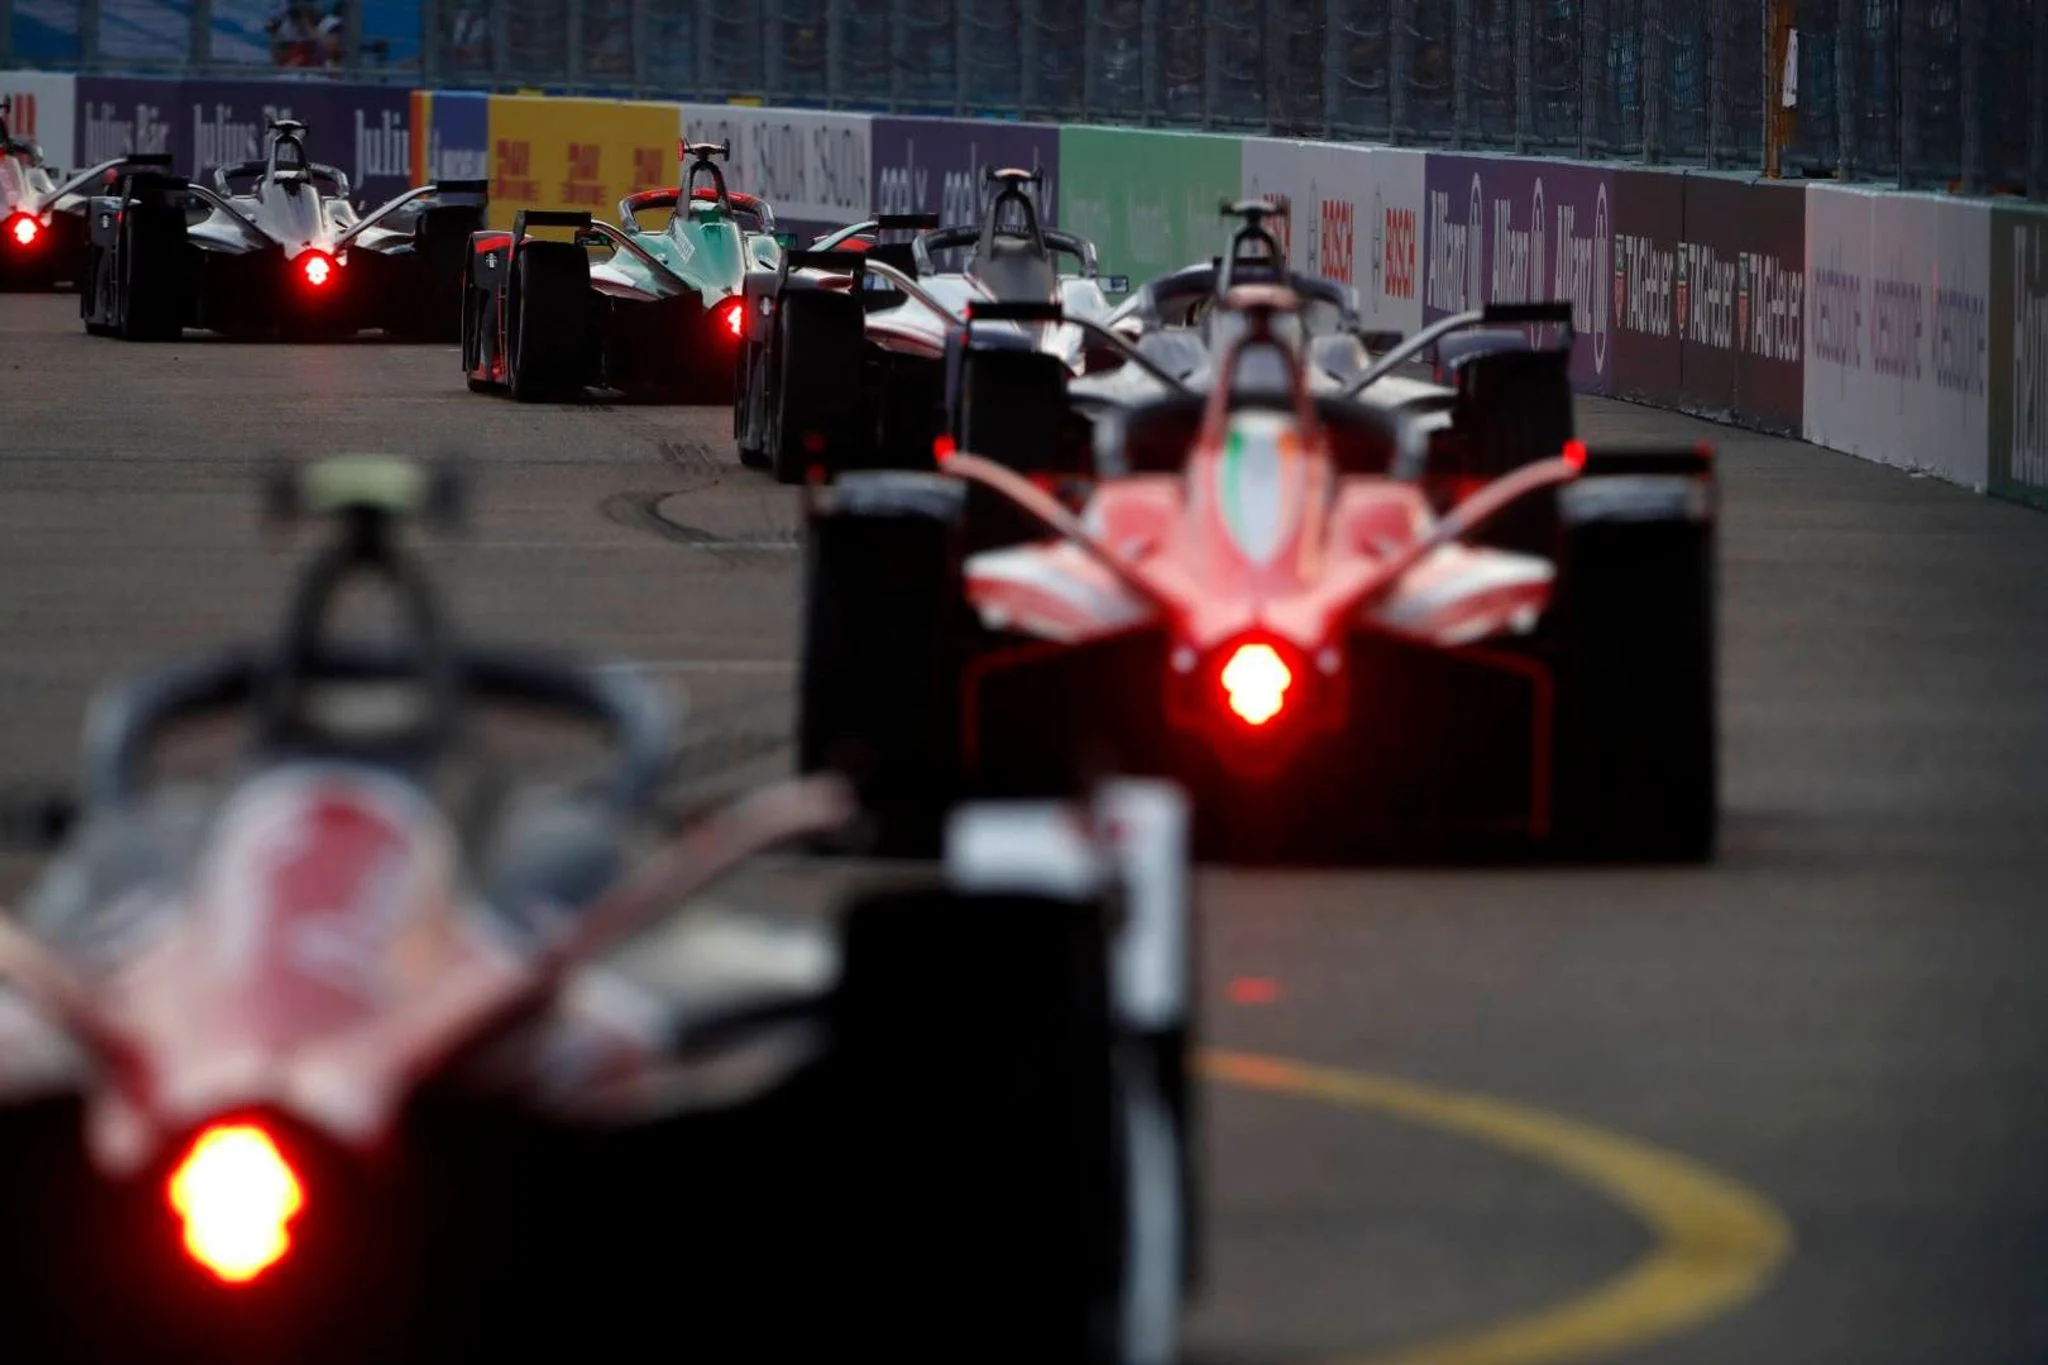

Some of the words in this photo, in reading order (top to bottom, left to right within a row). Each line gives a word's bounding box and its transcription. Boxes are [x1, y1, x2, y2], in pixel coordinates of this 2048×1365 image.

[1322, 199, 1354, 284] BOSCH
[1385, 207, 1416, 300] BOSCH
[1427, 189, 1468, 316] Allianz
[1491, 199, 1530, 305] Allianz
[1554, 204, 1593, 334] Allianz
